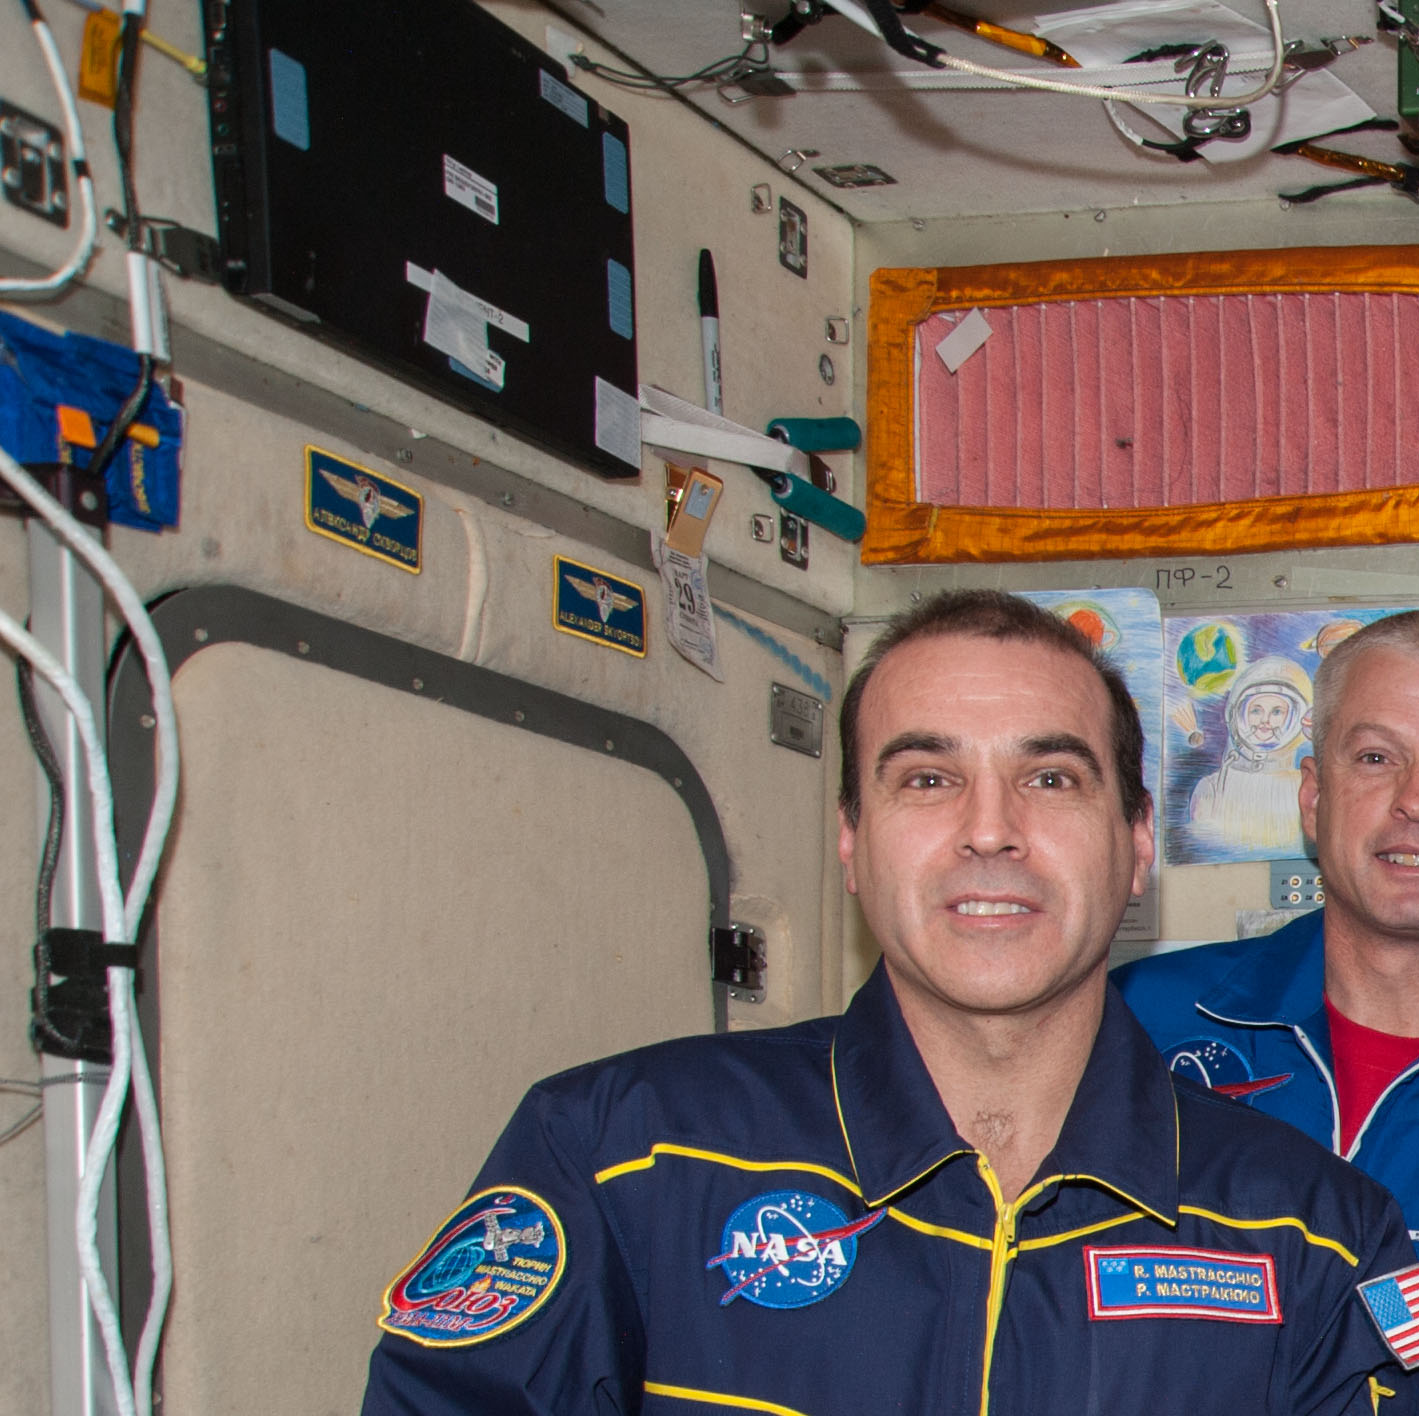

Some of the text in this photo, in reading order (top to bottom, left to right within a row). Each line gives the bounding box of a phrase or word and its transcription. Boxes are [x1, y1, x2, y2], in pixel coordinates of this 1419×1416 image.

[674, 577, 696, 615] 29
[559, 611, 602, 633] ALEXANDER
[730, 1230, 847, 1266] NASA
[475, 1264, 548, 1286] MASTRACCHIO
[1134, 1264, 1263, 1287] R. MASTRACCHIO
[494, 1281, 537, 1297] WAKATA
[1136, 1283, 1261, 1304] Р. МАСТРАККИО
